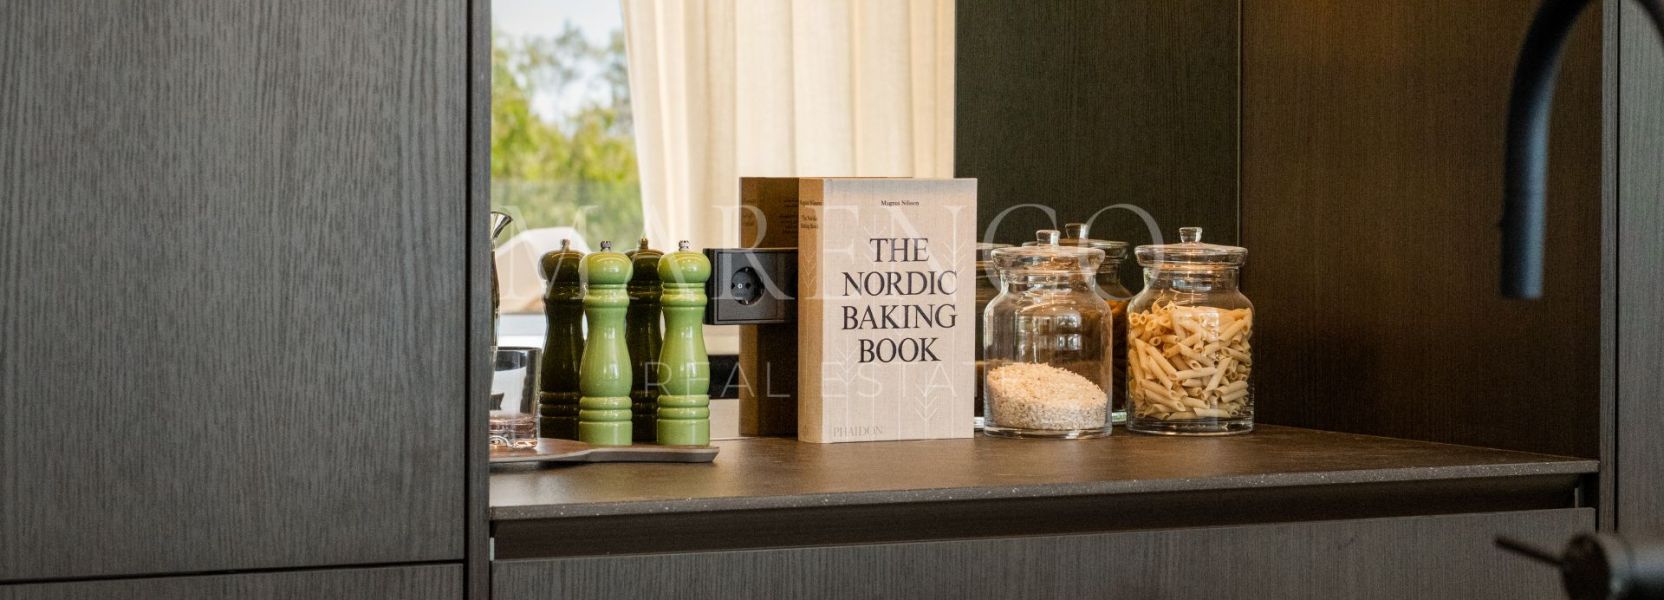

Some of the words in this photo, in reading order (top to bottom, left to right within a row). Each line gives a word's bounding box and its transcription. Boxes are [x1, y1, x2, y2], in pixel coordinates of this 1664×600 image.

[869, 237, 929, 262] THE
[841, 270, 957, 296] NORDIC
[841, 303, 958, 330] BAKING
[858, 337, 941, 363] BOOK
[833, 425, 883, 437] PHAIDON
